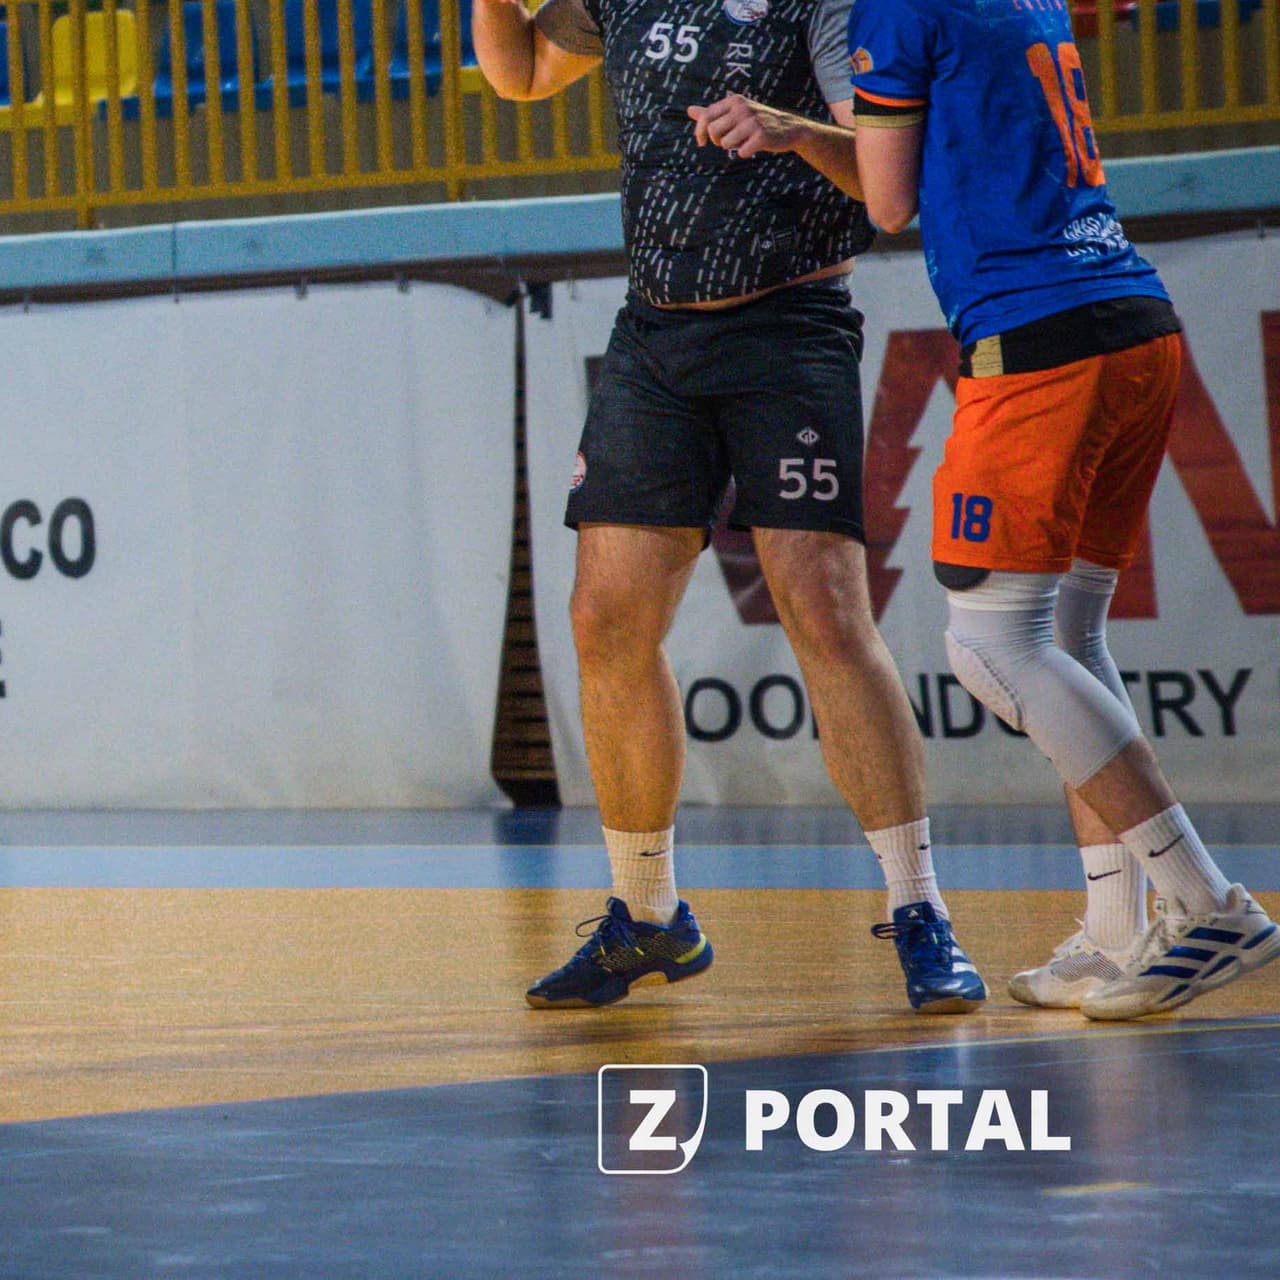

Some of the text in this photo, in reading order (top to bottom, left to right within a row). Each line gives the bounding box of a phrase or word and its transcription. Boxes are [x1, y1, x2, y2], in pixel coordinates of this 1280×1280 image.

[645, 22, 701, 63] 55
[726, 42, 754, 79] RK
[1026, 42, 1107, 189] 18
[779, 458, 840, 500] 55
[951, 492, 993, 543] 18
[683, 673, 820, 743] OO
